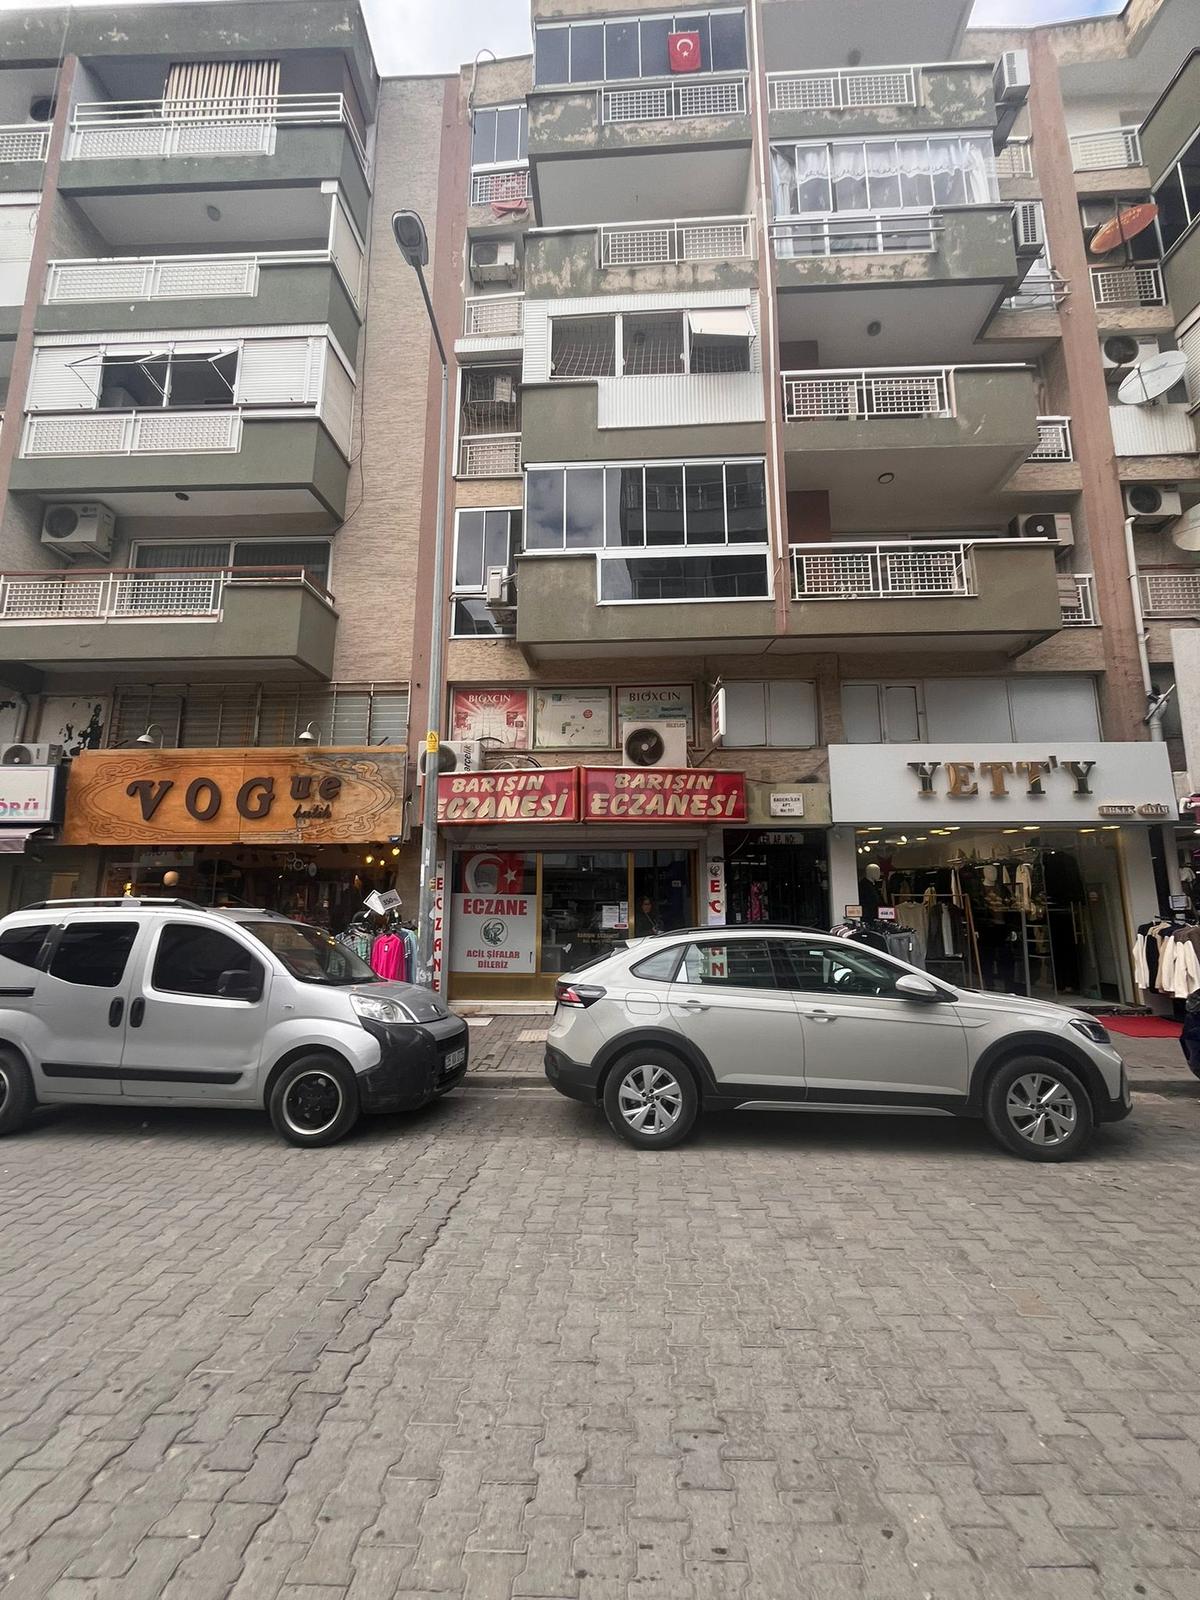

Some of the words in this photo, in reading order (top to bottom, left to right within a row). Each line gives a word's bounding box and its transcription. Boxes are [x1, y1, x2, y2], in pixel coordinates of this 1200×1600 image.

[451, 775, 545, 796] BARIŞIN
[614, 773, 715, 793] BARIŞIN
[590, 790, 738, 816] ECZANESİ
[463, 898, 528, 916] ECZANE
[466, 949, 485, 958] ACİL
[487, 949, 520, 960] ŞİFALAR
[477, 959, 509, 969] DİLERİZ
